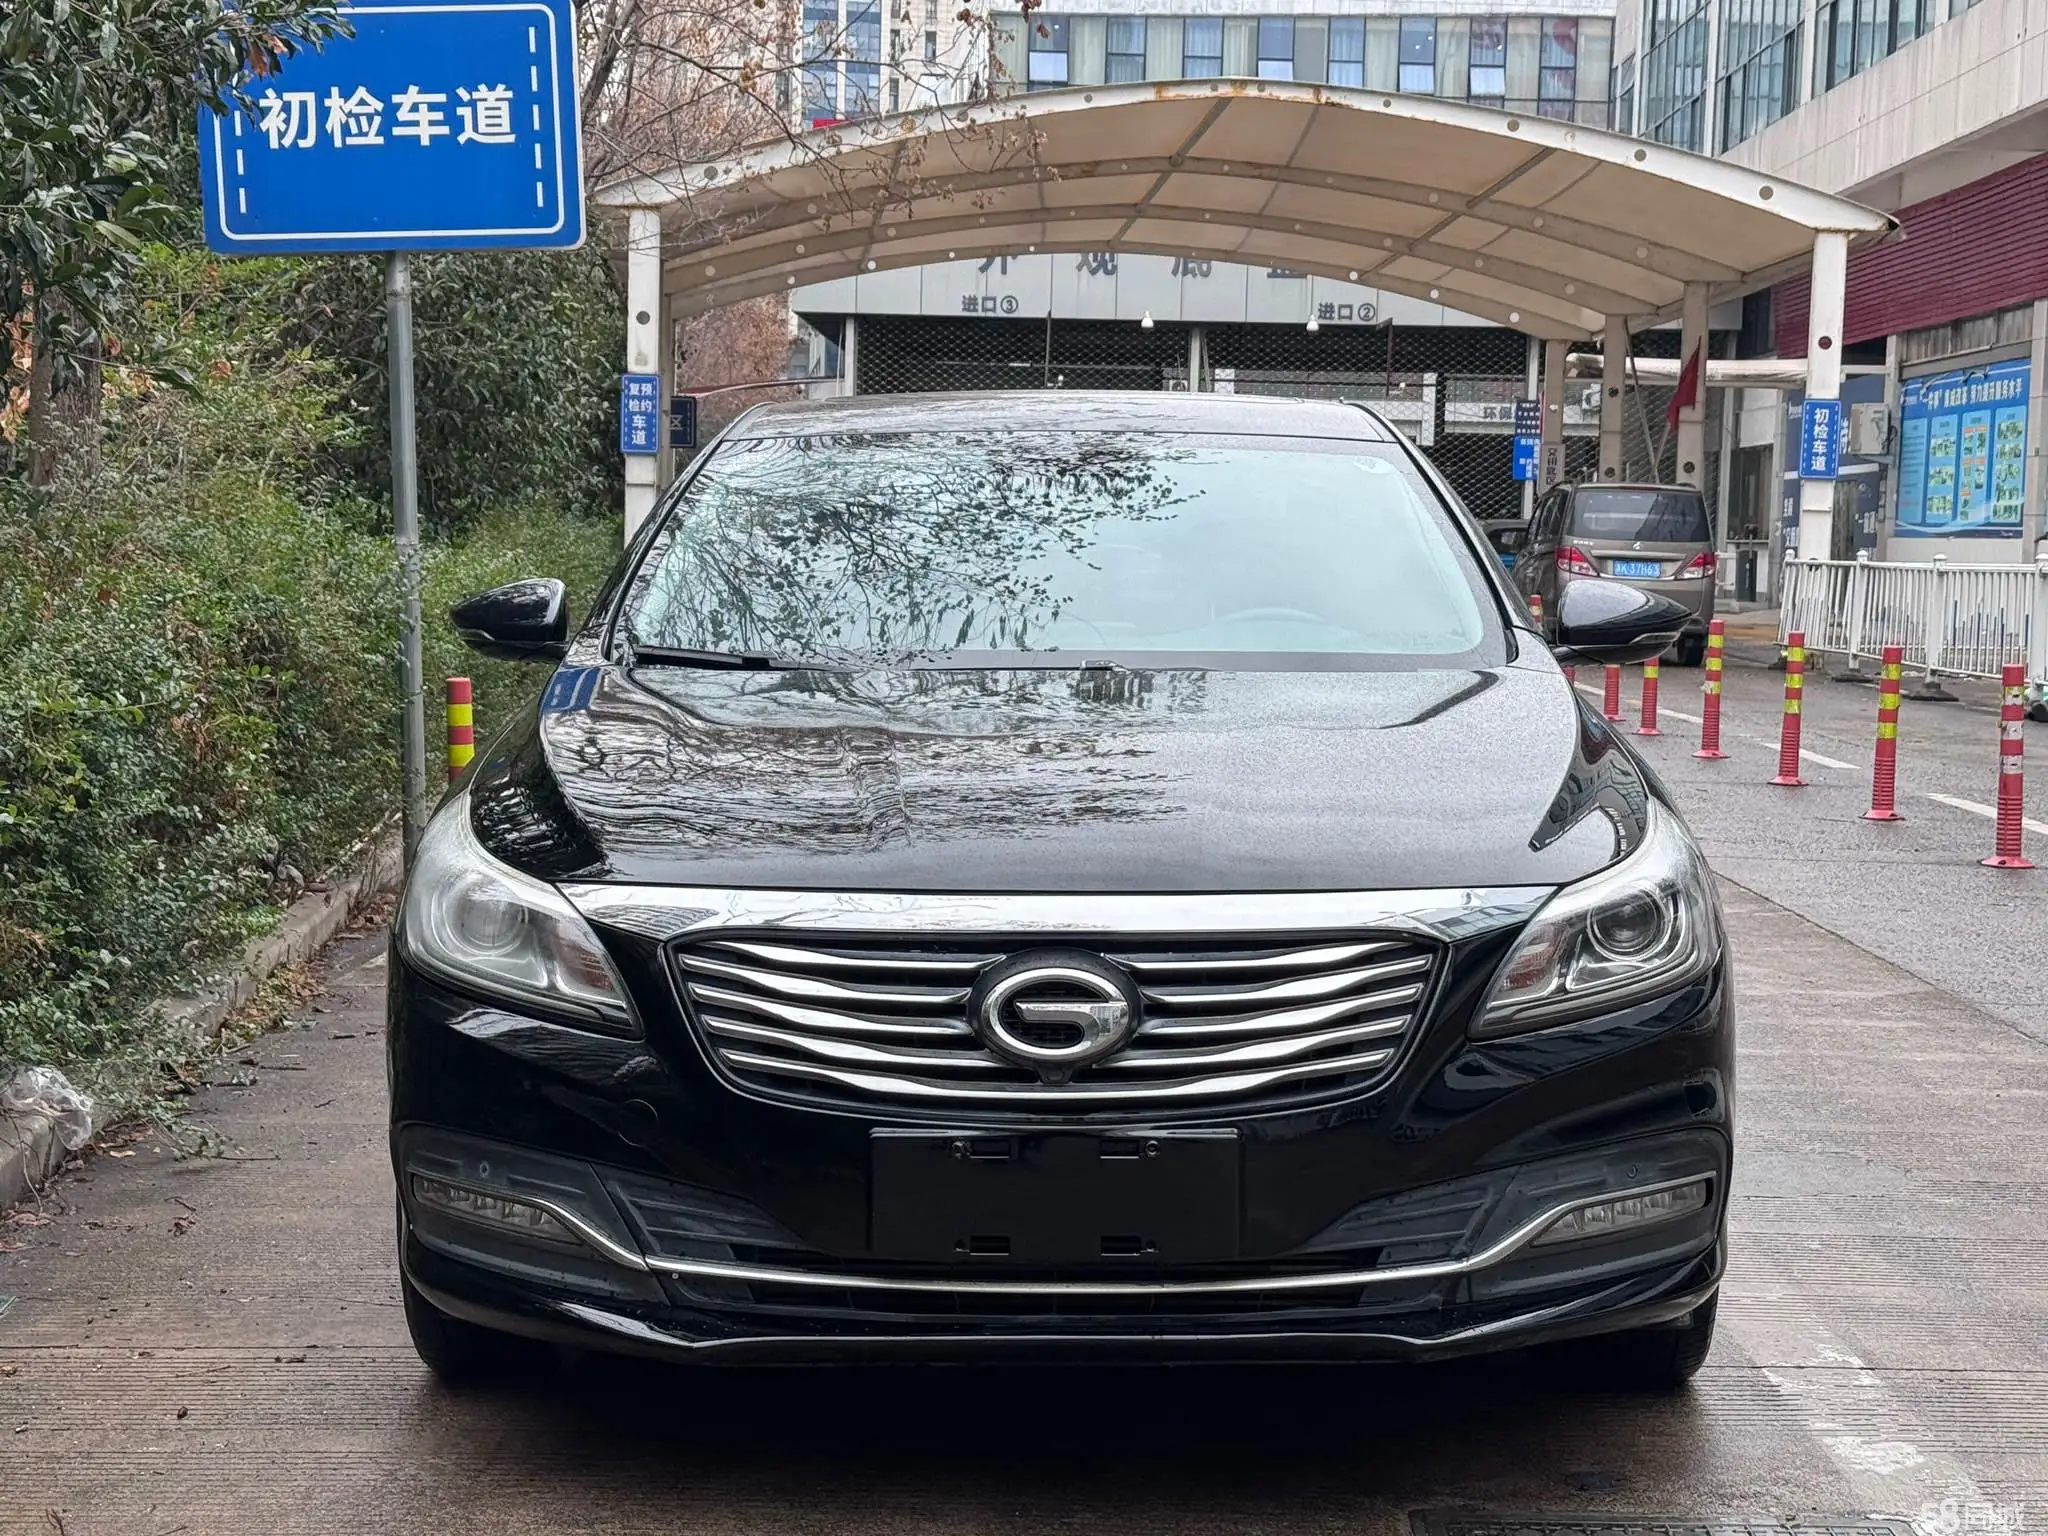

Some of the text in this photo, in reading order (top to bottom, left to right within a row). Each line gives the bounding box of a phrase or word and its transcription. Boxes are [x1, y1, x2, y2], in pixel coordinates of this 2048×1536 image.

[259, 83, 517, 150] 初检车道
[1811, 408, 1830, 471] 初检车道
